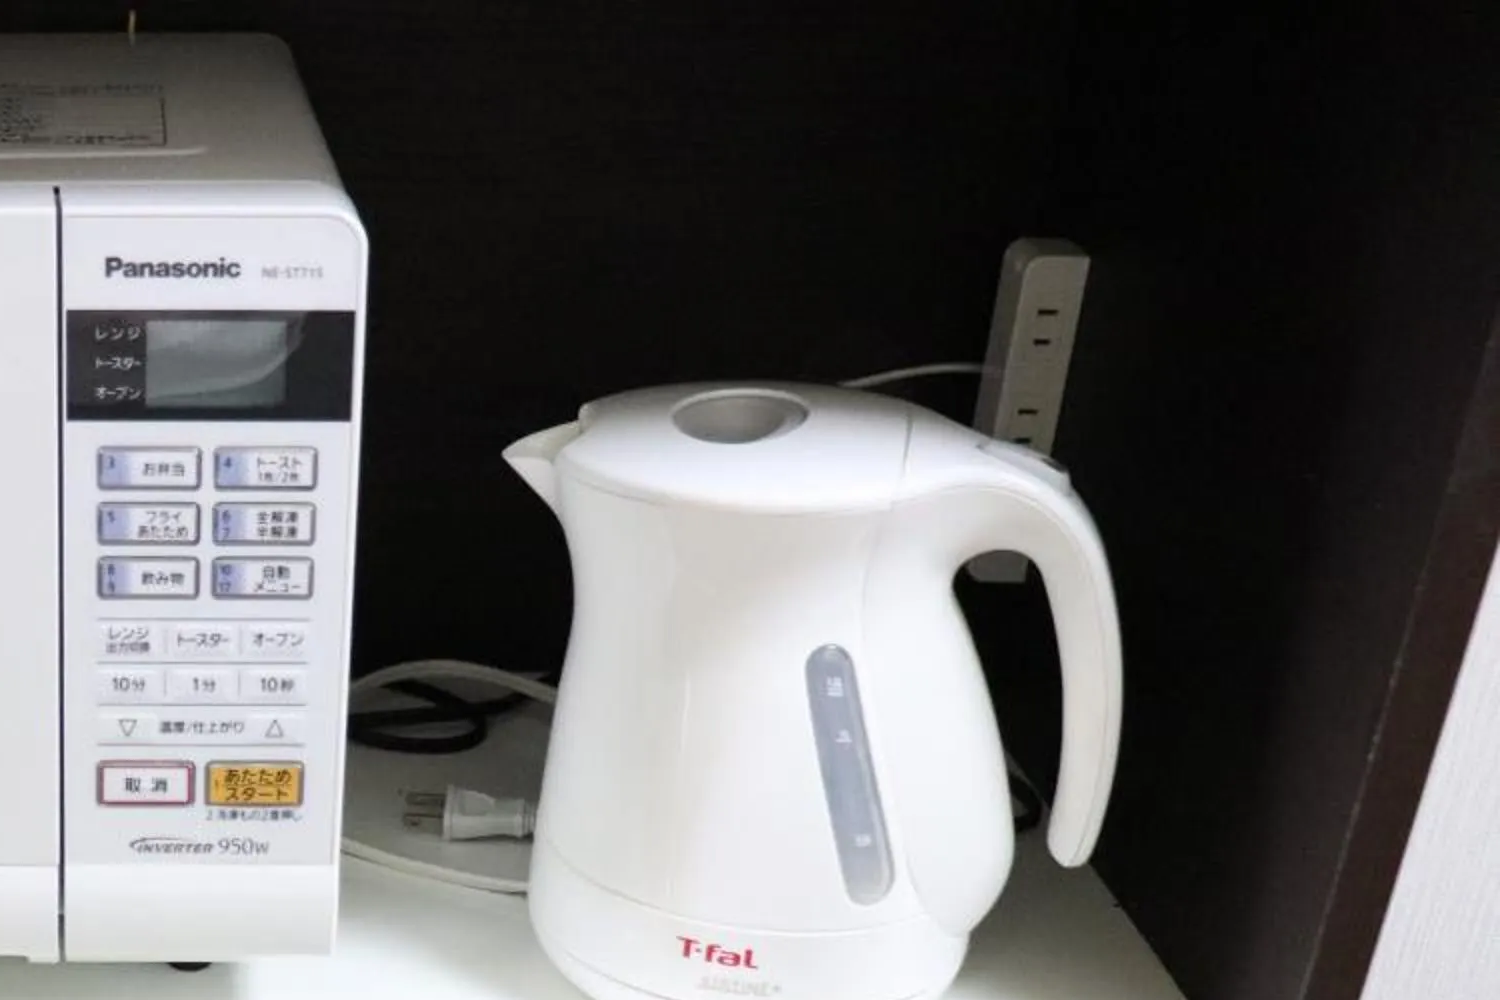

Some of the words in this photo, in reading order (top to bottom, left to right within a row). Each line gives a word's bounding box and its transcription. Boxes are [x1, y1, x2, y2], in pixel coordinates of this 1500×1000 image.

[104, 257, 241, 278] Panasonic
[95, 327, 141, 341] レンジ
[95, 356, 141, 370] トースター
[96, 386, 142, 400] オープン
[257, 456, 302, 470] トースト
[146, 511, 182, 524] フライ
[138, 526, 188, 539] あたため
[142, 572, 185, 586] 飲み物
[262, 565, 290, 580] 自動
[254, 582, 301, 593] メニュー
[107, 626, 149, 640] レンジ
[177, 633, 229, 647] トースター
[252, 633, 305, 647] オープン
[112, 677, 145, 692] 10分
[192, 677, 216, 692] 1分
[261, 677, 294, 692] 10秒
[223, 769, 293, 785] あたため
[225, 786, 290, 802] スタート
